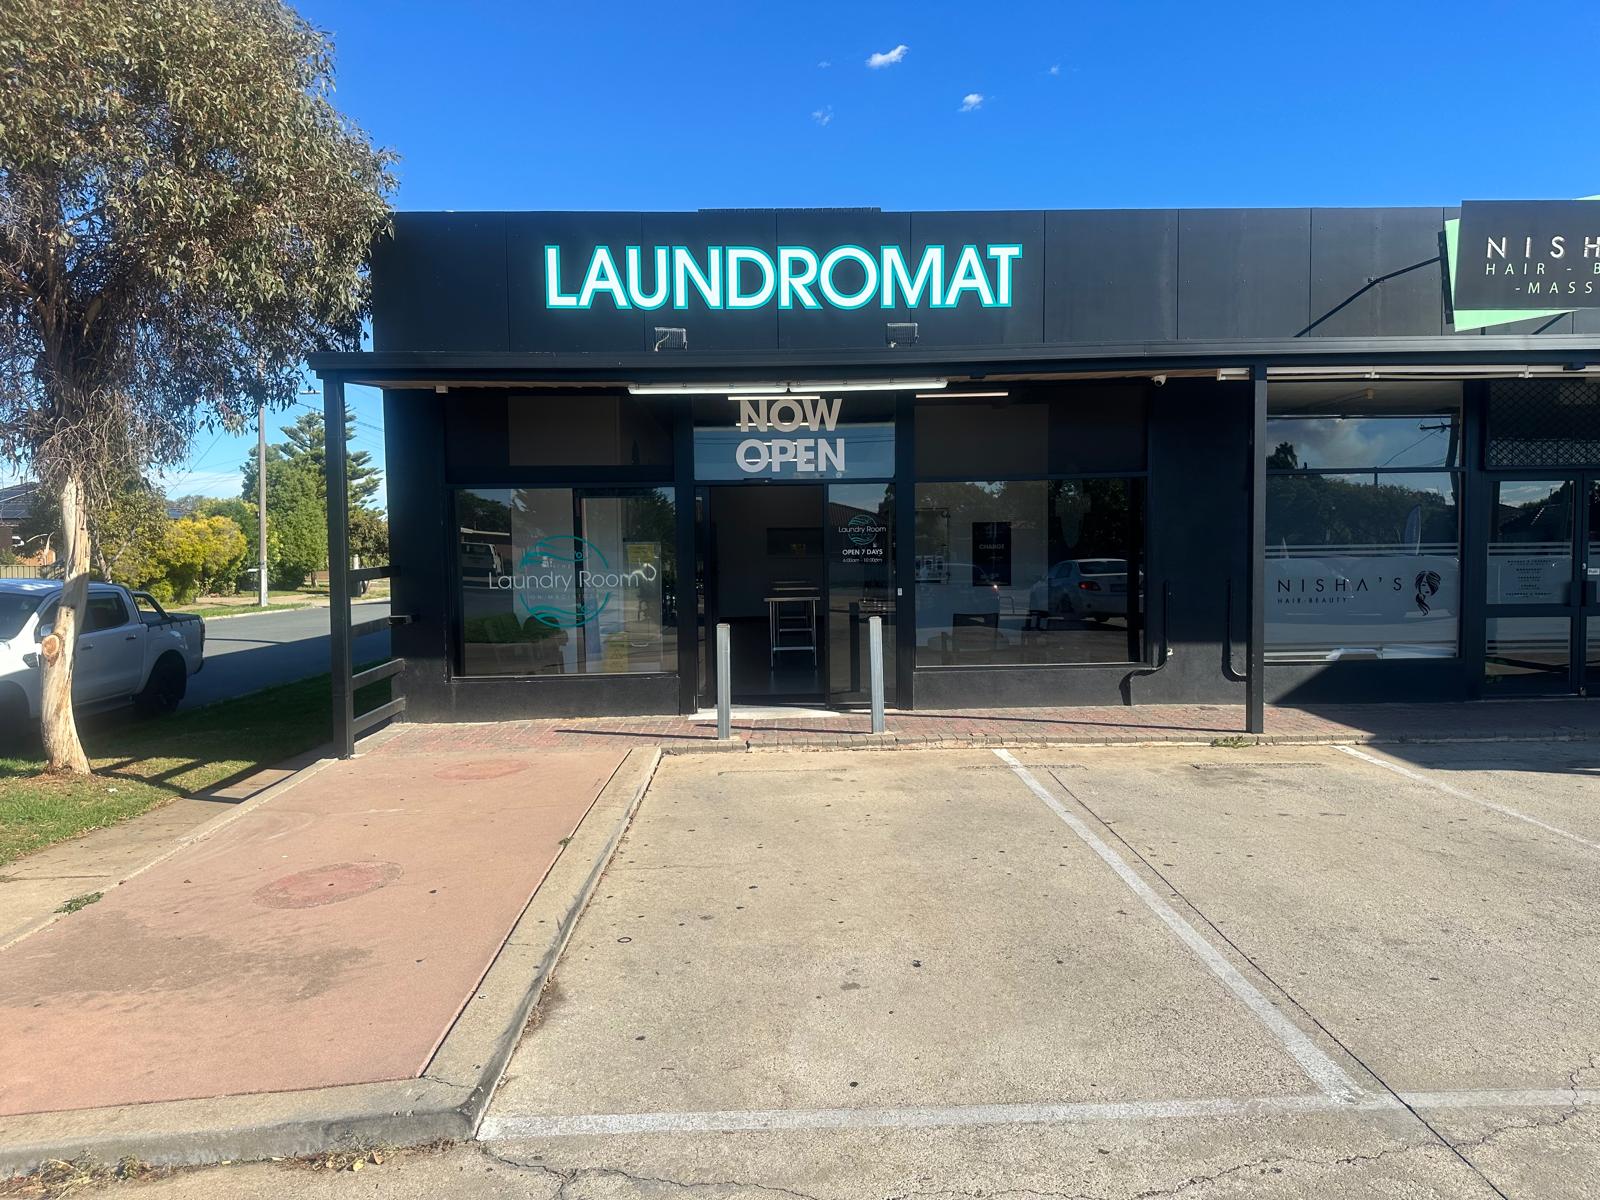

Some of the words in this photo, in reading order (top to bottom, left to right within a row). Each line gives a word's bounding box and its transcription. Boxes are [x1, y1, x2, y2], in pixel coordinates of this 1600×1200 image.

[1487, 236, 1600, 259] NISH
[544, 243, 1023, 309] LAUNDROMAT
[1486, 263, 1545, 275] HAIR
[740, 398, 842, 433] NOW
[736, 438, 846, 473] OPEN
[838, 526, 865, 534] Laundry
[488, 571, 571, 592] Laundry
[579, 570, 639, 589] Room
[1277, 576, 1403, 593] NISHA'S
